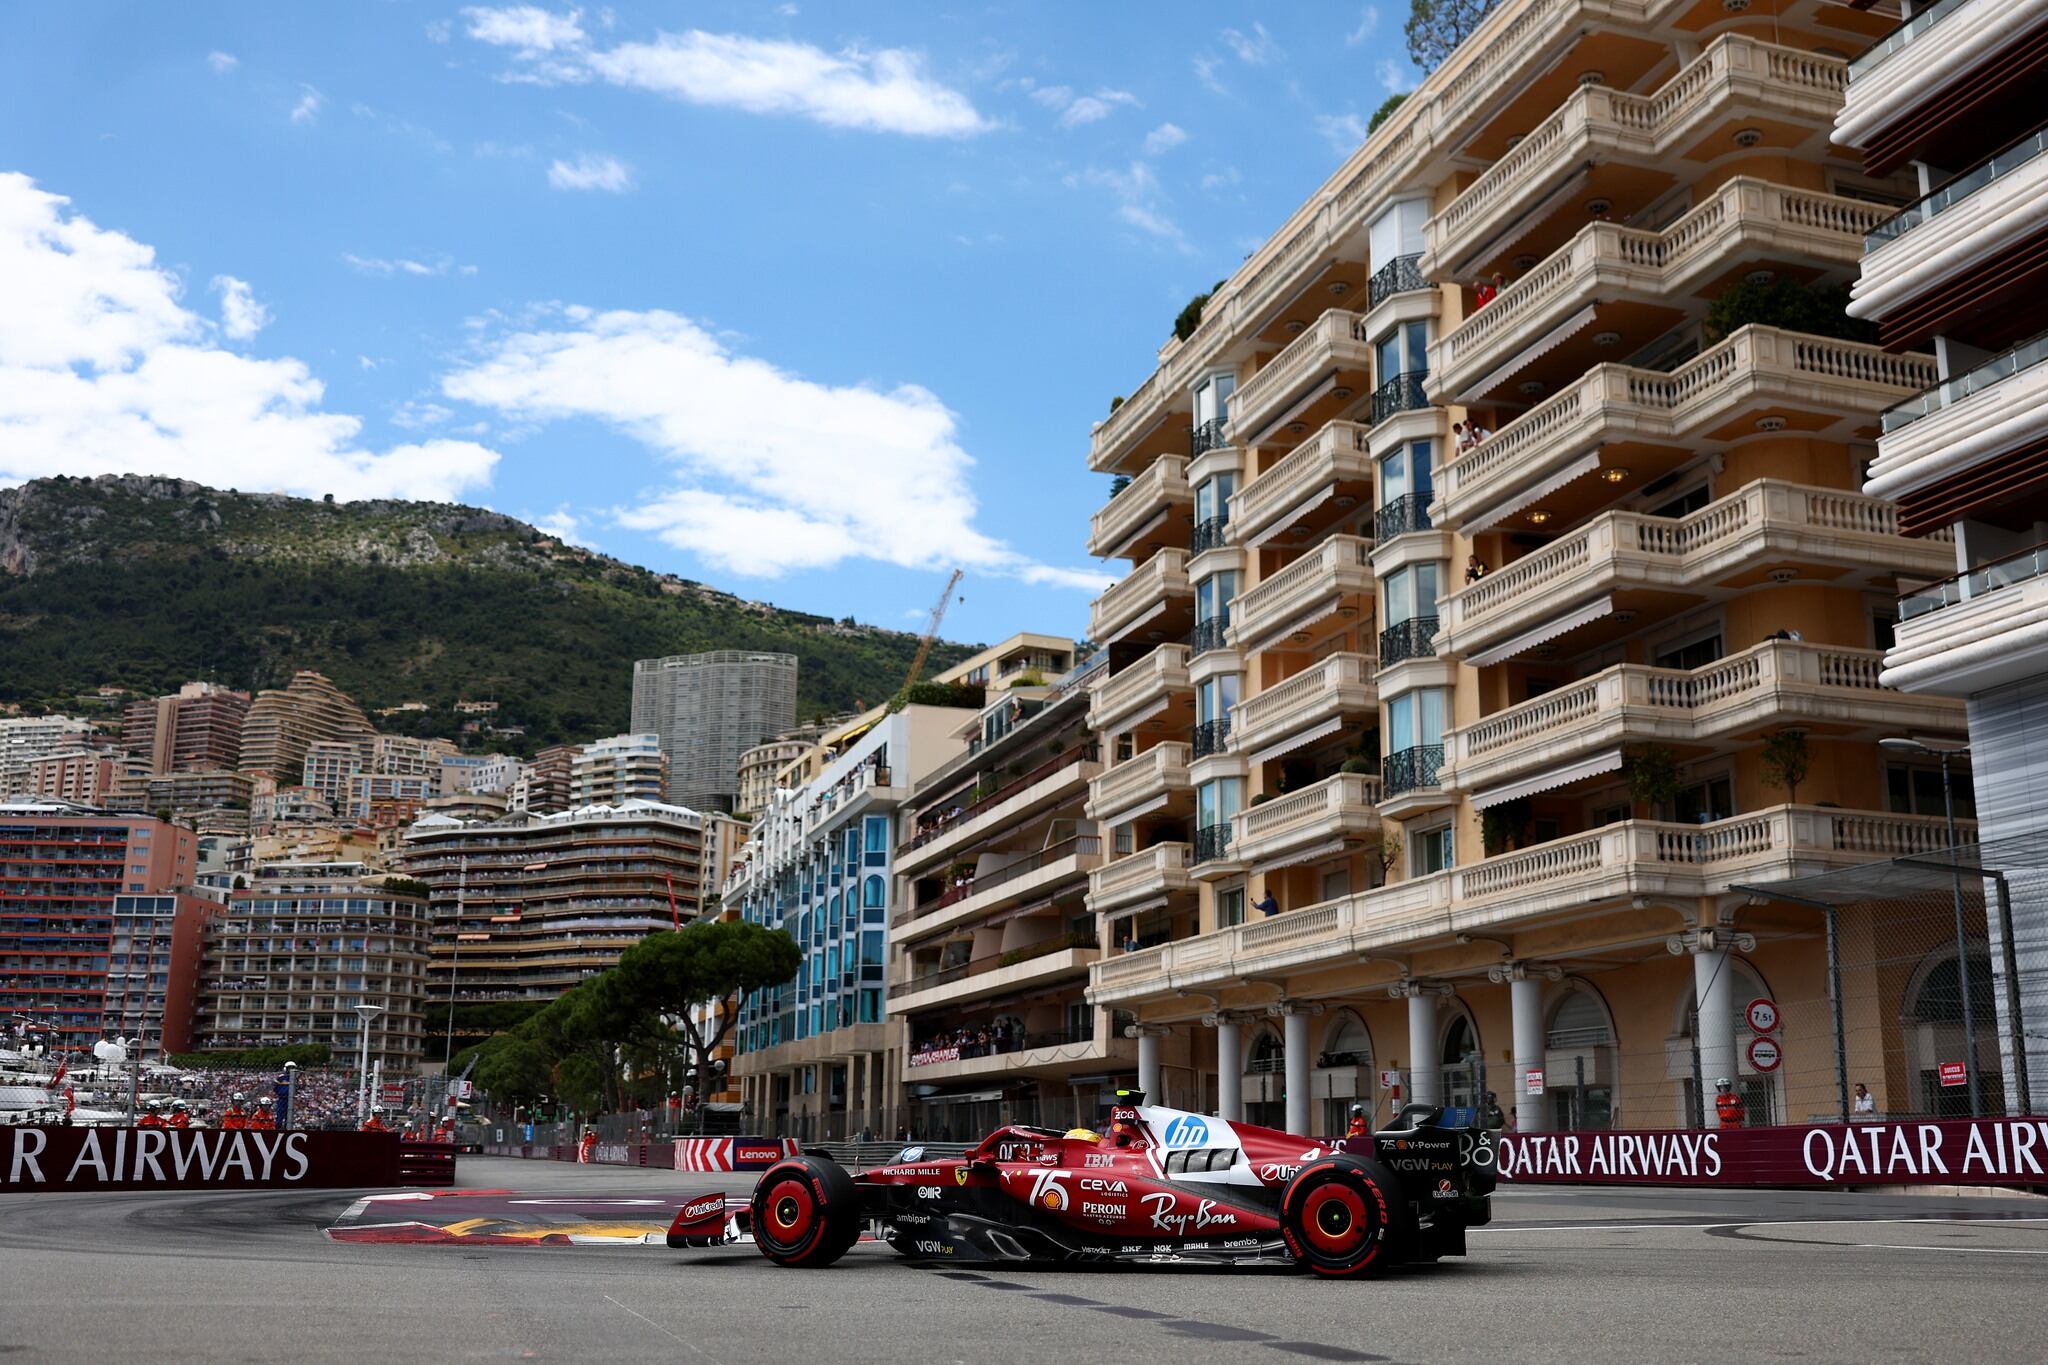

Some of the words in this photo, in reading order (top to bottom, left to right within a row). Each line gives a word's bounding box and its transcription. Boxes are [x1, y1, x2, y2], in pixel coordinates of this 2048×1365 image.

[1115, 1111, 1134, 1119] ZCG
[1168, 1115, 1206, 1149] hp
[1407, 1141, 1451, 1149] V-Power
[65, 1129, 309, 1182] AIRWAYS
[740, 1150, 777, 1159] Lenovo
[1497, 1136, 1582, 1178] QATAR
[1589, 1133, 1721, 1177] AIRWAYS
[1803, 1125, 1949, 1181] QATAR
[1962, 1122, 2048, 1175] AIR
[1083, 1153, 1115, 1168] IBM
[1389, 1159, 1430, 1171] VGW
[1431, 1162, 1453, 1171] PLAY
[883, 1168, 916, 1176] RICHARD
[917, 1168, 941, 1176] MILLE
[1082, 1201, 1127, 1215] PERONI
[915, 1240, 941, 1253] VGW
[1183, 1242, 1209, 1250] MAHLE
[1223, 1237, 1258, 1248] brembo
[1121, 1245, 1142, 1253] SKF
[1153, 1245, 1172, 1254] NGK
